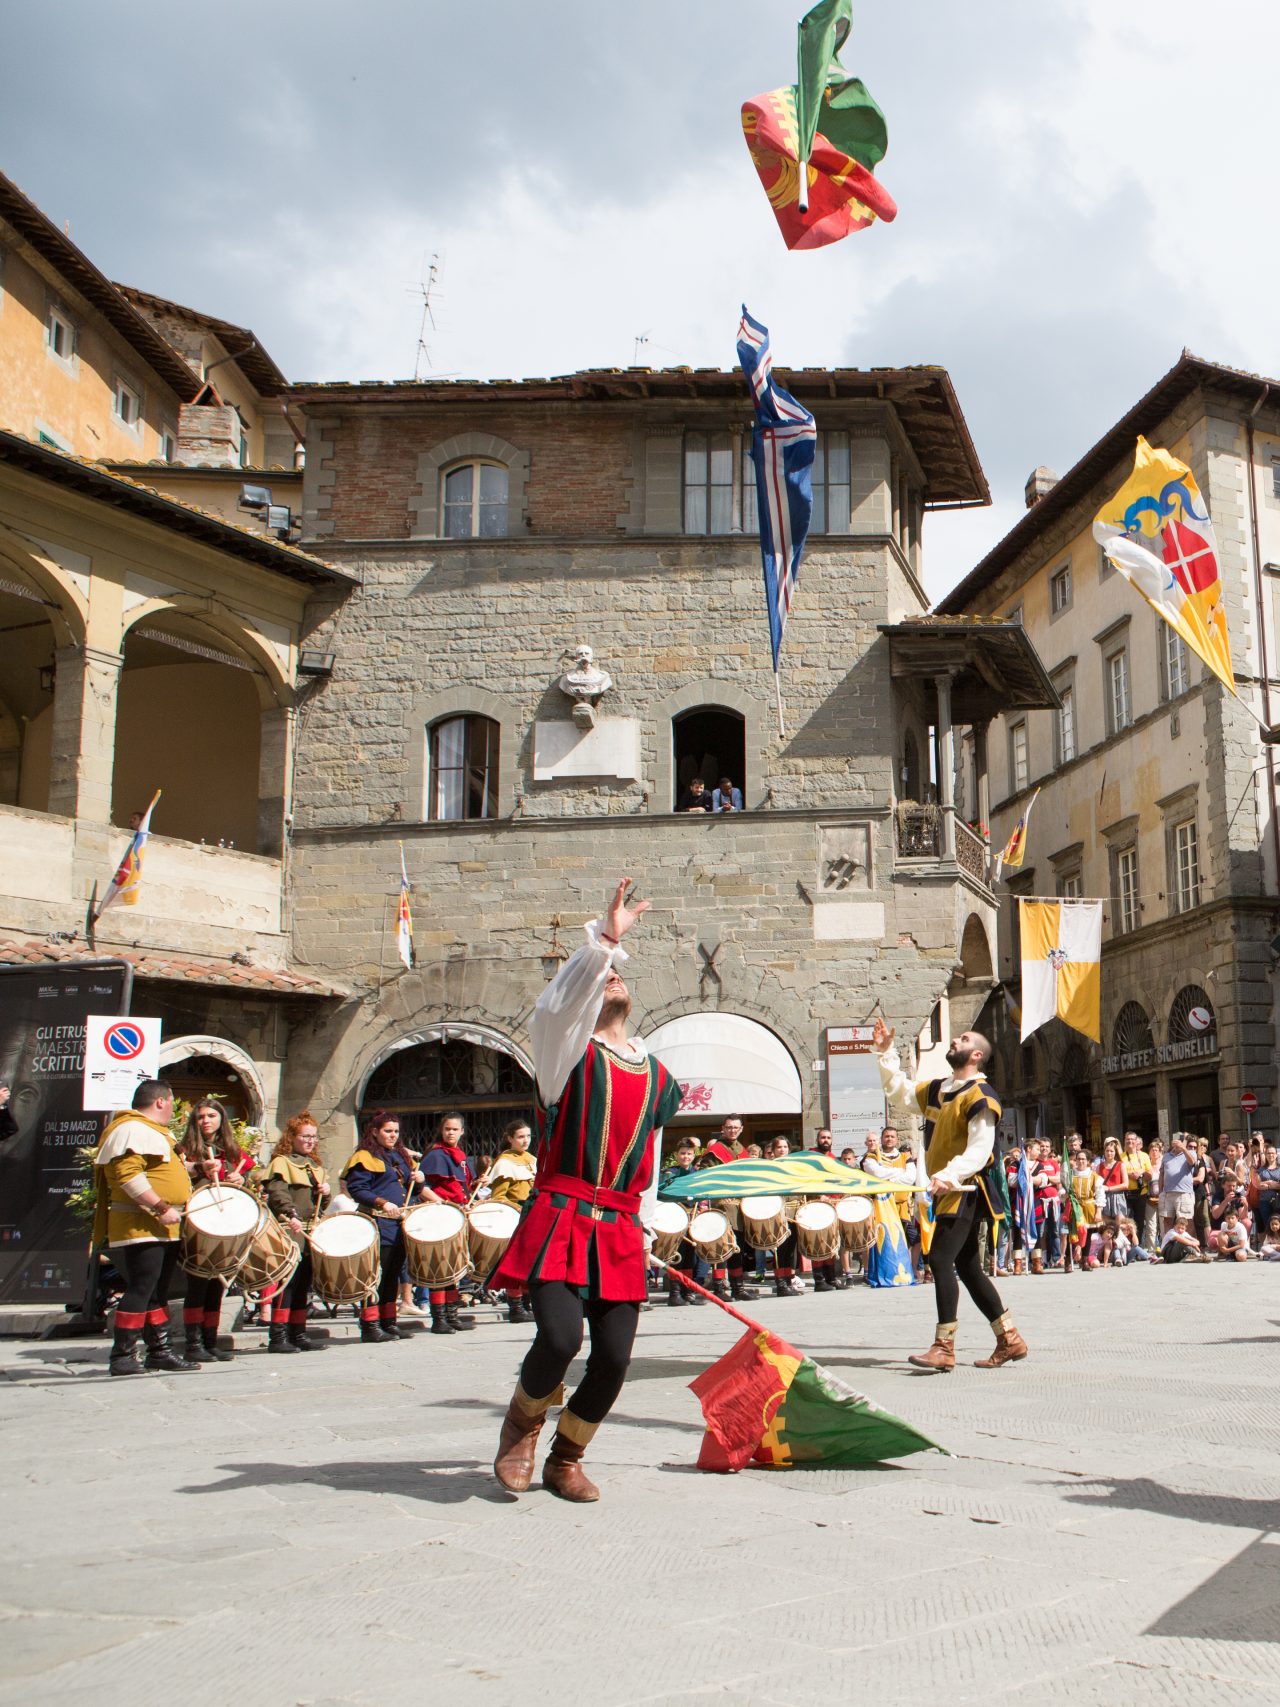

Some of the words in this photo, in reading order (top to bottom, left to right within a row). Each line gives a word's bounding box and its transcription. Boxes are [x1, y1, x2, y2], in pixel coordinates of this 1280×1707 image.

[36, 1026, 53, 1040] GLI
[44, 1121, 58, 1132] DAL
[59, 1121, 69, 1132] 19
[69, 1120, 97, 1131] MARZO
[43, 1135, 53, 1146] AL
[54, 1135, 64, 1146] 31
[66, 1134, 96, 1145] LUGLIO
